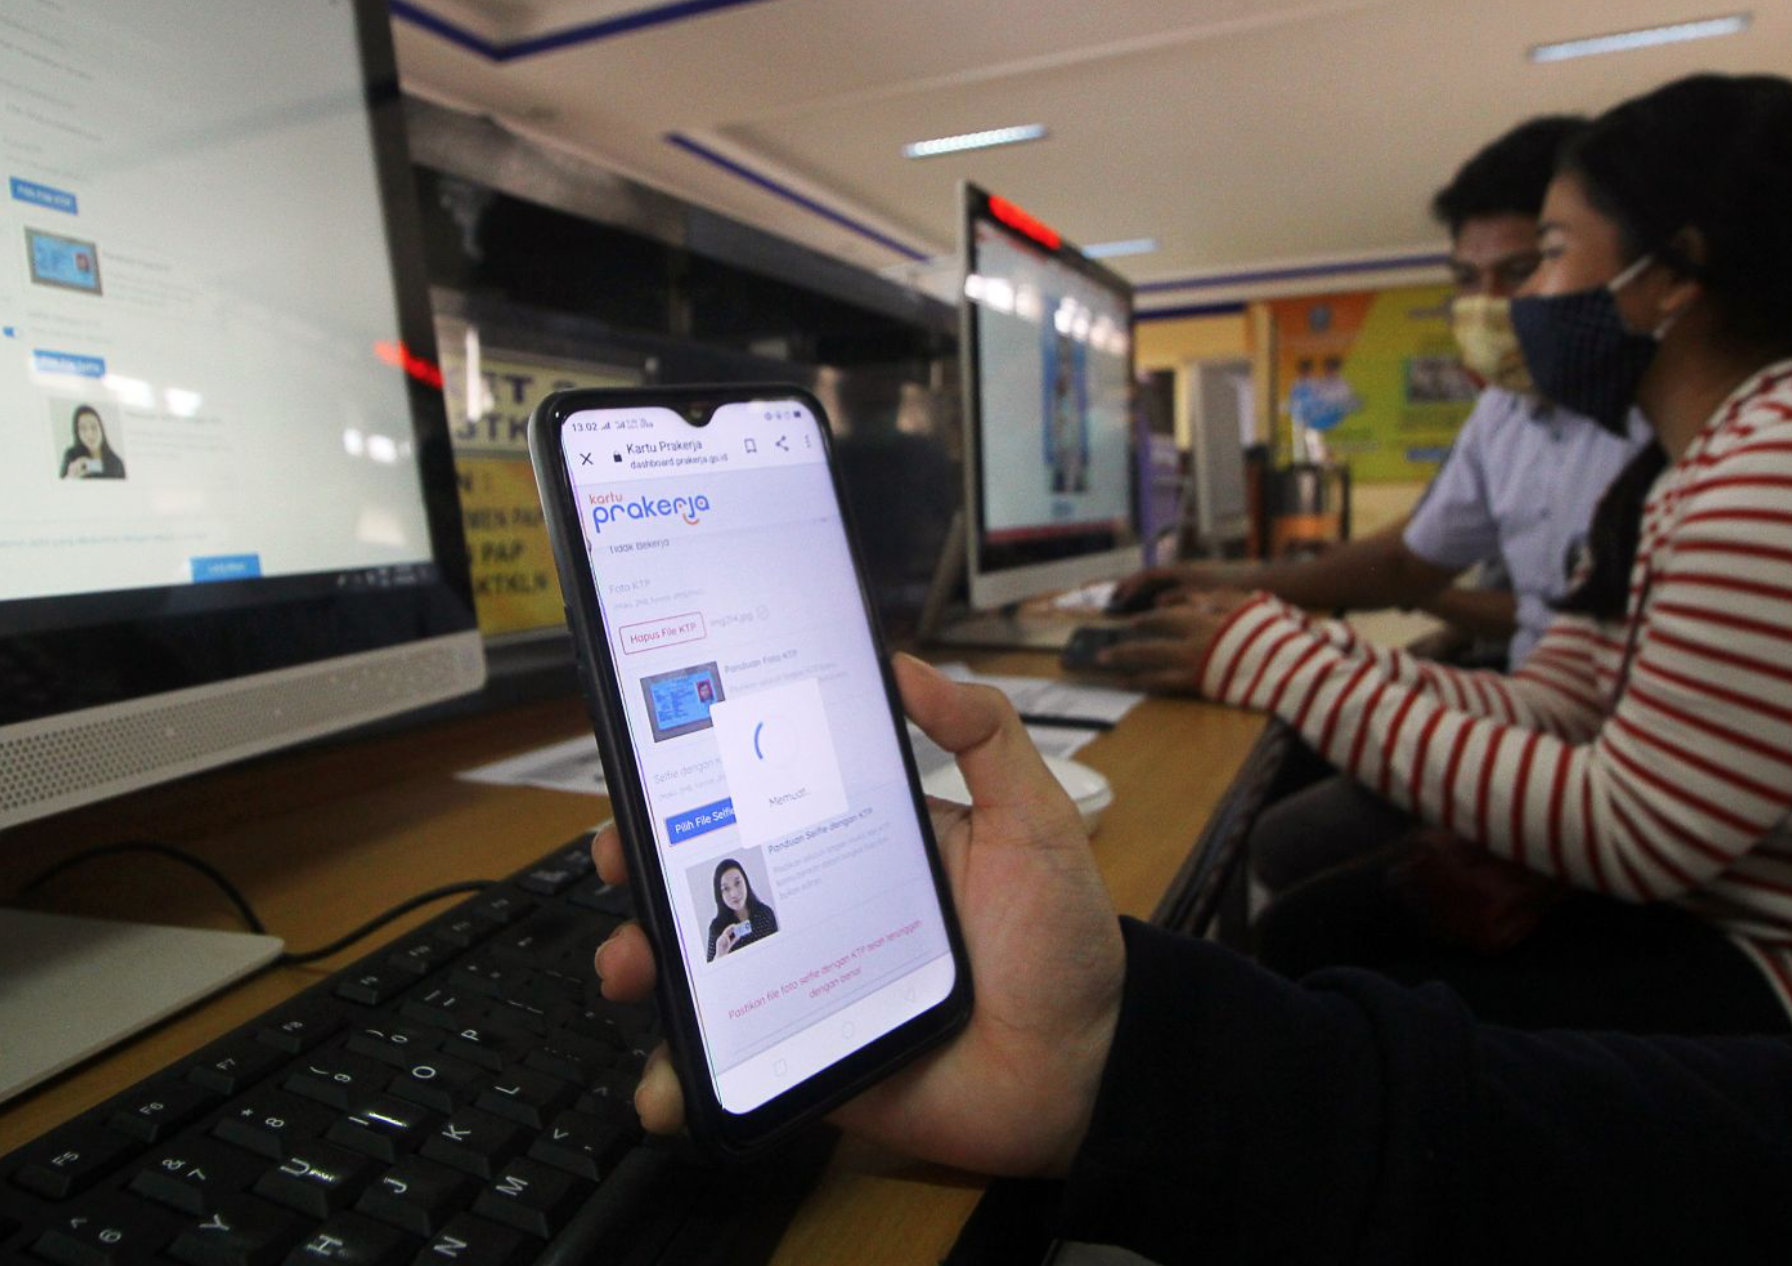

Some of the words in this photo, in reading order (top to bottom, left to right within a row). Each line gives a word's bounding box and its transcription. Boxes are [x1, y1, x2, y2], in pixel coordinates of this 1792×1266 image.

[572, 422, 598, 432] 13.02
[626, 442, 657, 455] Kartu
[659, 440, 702, 453] Prakerja
[589, 492, 622, 505] kartu
[593, 495, 710, 533] prakerja
[609, 582, 631, 593] Foto
[632, 580, 650, 591] KTP
[630, 630, 660, 644] Hapus
[661, 627, 677, 638] File
[679, 622, 697, 633] KTP
[653, 765, 679, 783] Selfie
[680, 758, 714, 778] dengan
[675, 819, 694, 834] Pilih
[695, 814, 711, 826] File
[768, 834, 804, 855] Panduan
[805, 826, 828, 841] Selfie
[829, 813, 857, 832] dengan
[728, 997, 766, 1019] Pastikan
[766, 990, 780, 1004] file
[780, 981, 798, 1000] foto
[799, 970, 820, 986] selfie
[820, 956, 850, 977] dengan
[851, 946, 866, 962] KTP
[809, 978, 839, 1000] dengan
[442, 1124, 471, 1141] K
[384, 1176, 407, 1193] J
[496, 1175, 528, 1196] M
[200, 1214, 230, 1231] Y
[307, 1233, 343, 1256] H
